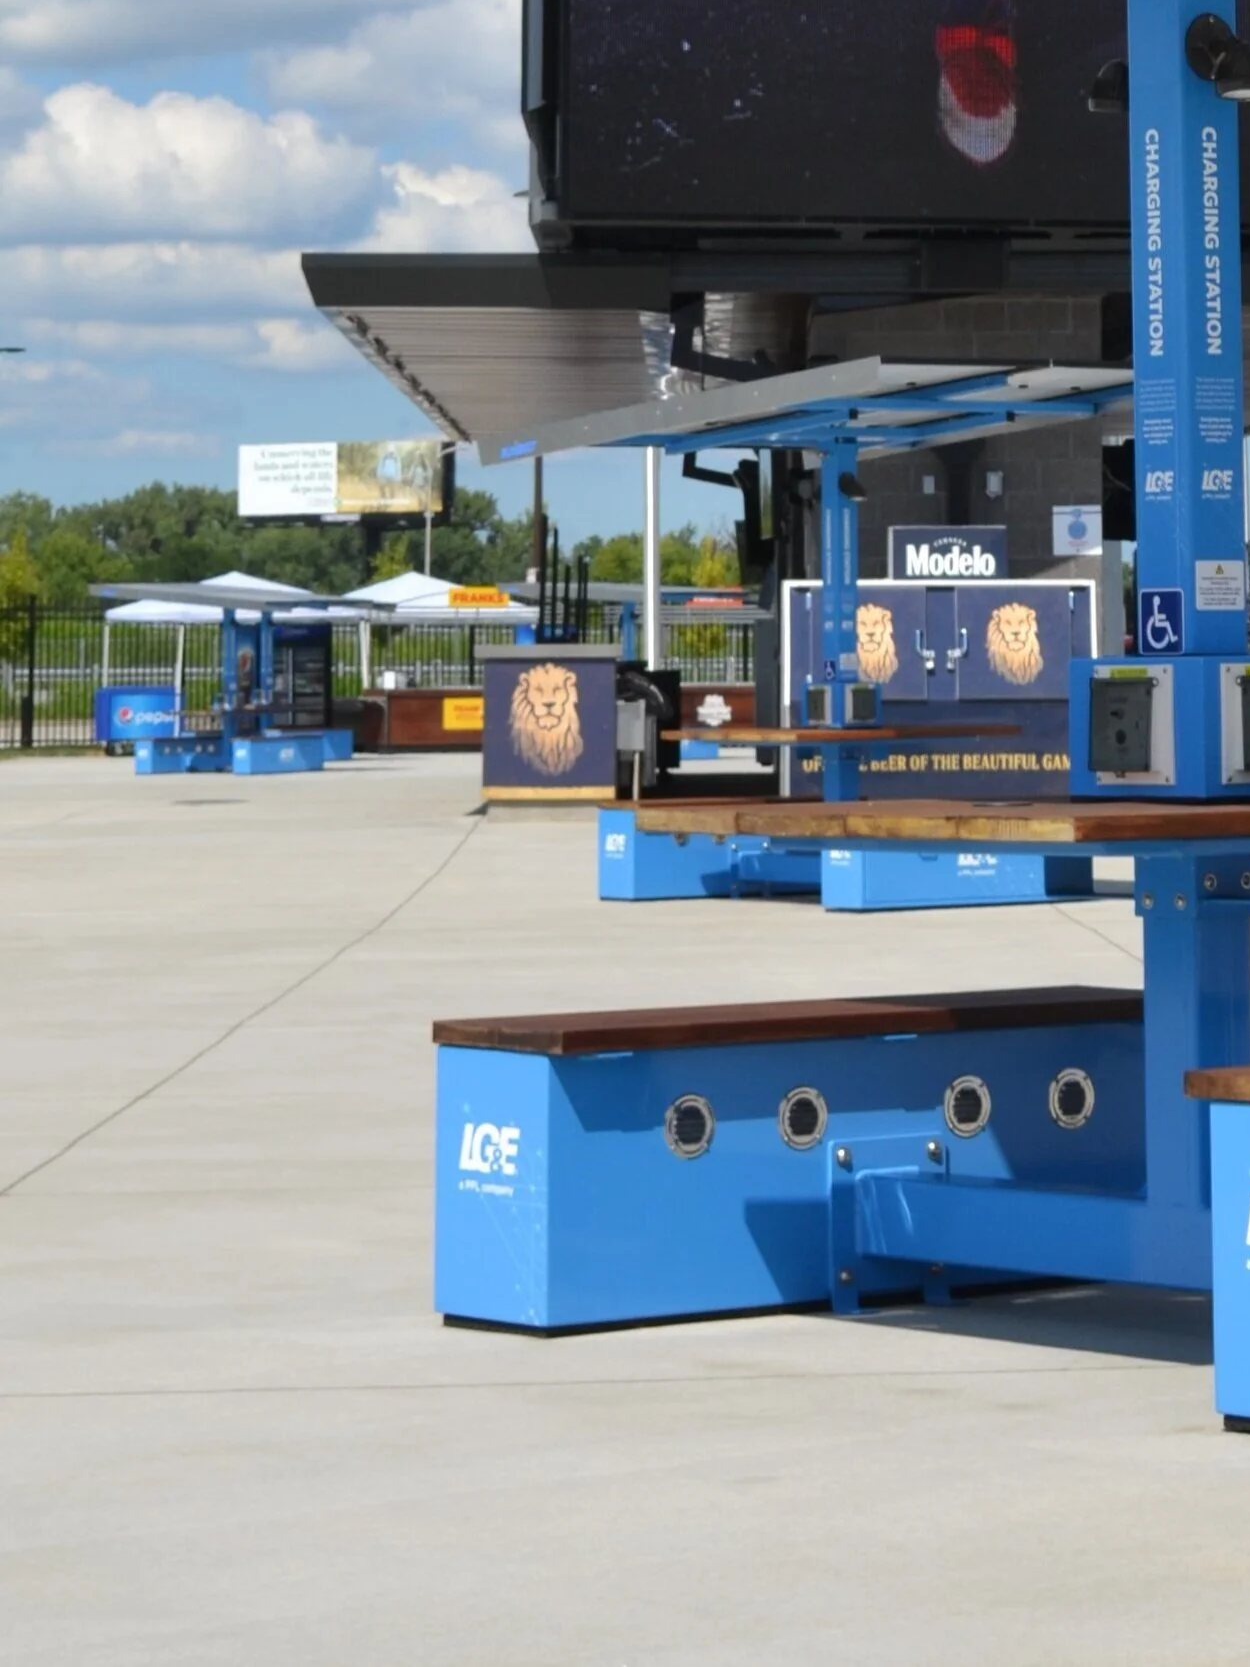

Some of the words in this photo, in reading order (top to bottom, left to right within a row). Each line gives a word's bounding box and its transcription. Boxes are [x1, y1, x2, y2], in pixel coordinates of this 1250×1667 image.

[1145, 128, 1161, 251] CHARGING
[1202, 126, 1220, 250] CHARGING
[1148, 257, 1164, 356] STATION
[1205, 255, 1222, 355] STATION
[906, 543, 996, 576] Modelo
[909, 754, 928, 771] OF
[931, 753, 960, 771] THE
[962, 752, 1041, 772] BEAUTIFUL
[459, 1121, 521, 1176] LG&E
